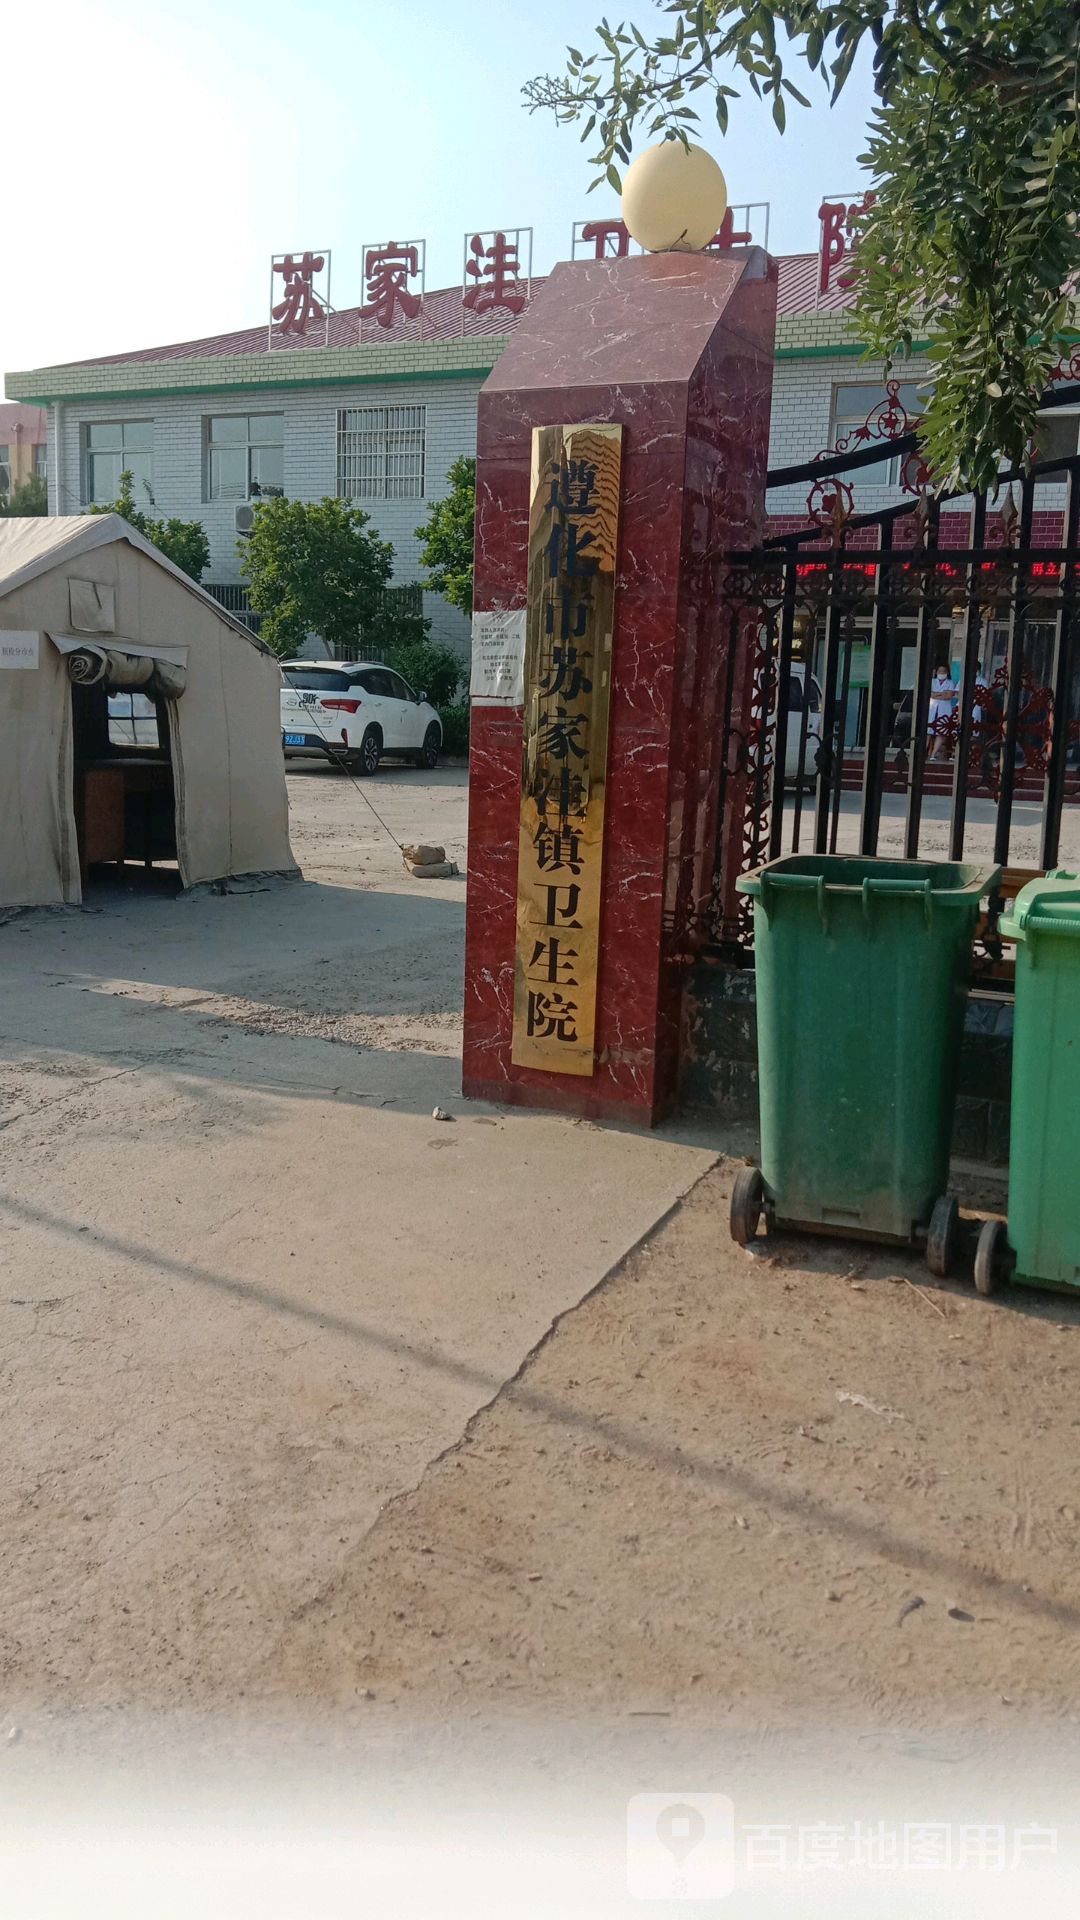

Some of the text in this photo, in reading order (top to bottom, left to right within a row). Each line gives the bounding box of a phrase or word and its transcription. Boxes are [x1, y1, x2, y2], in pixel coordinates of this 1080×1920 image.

[526, 459, 601, 1042] 遵化市苏家洼镇卫生院
